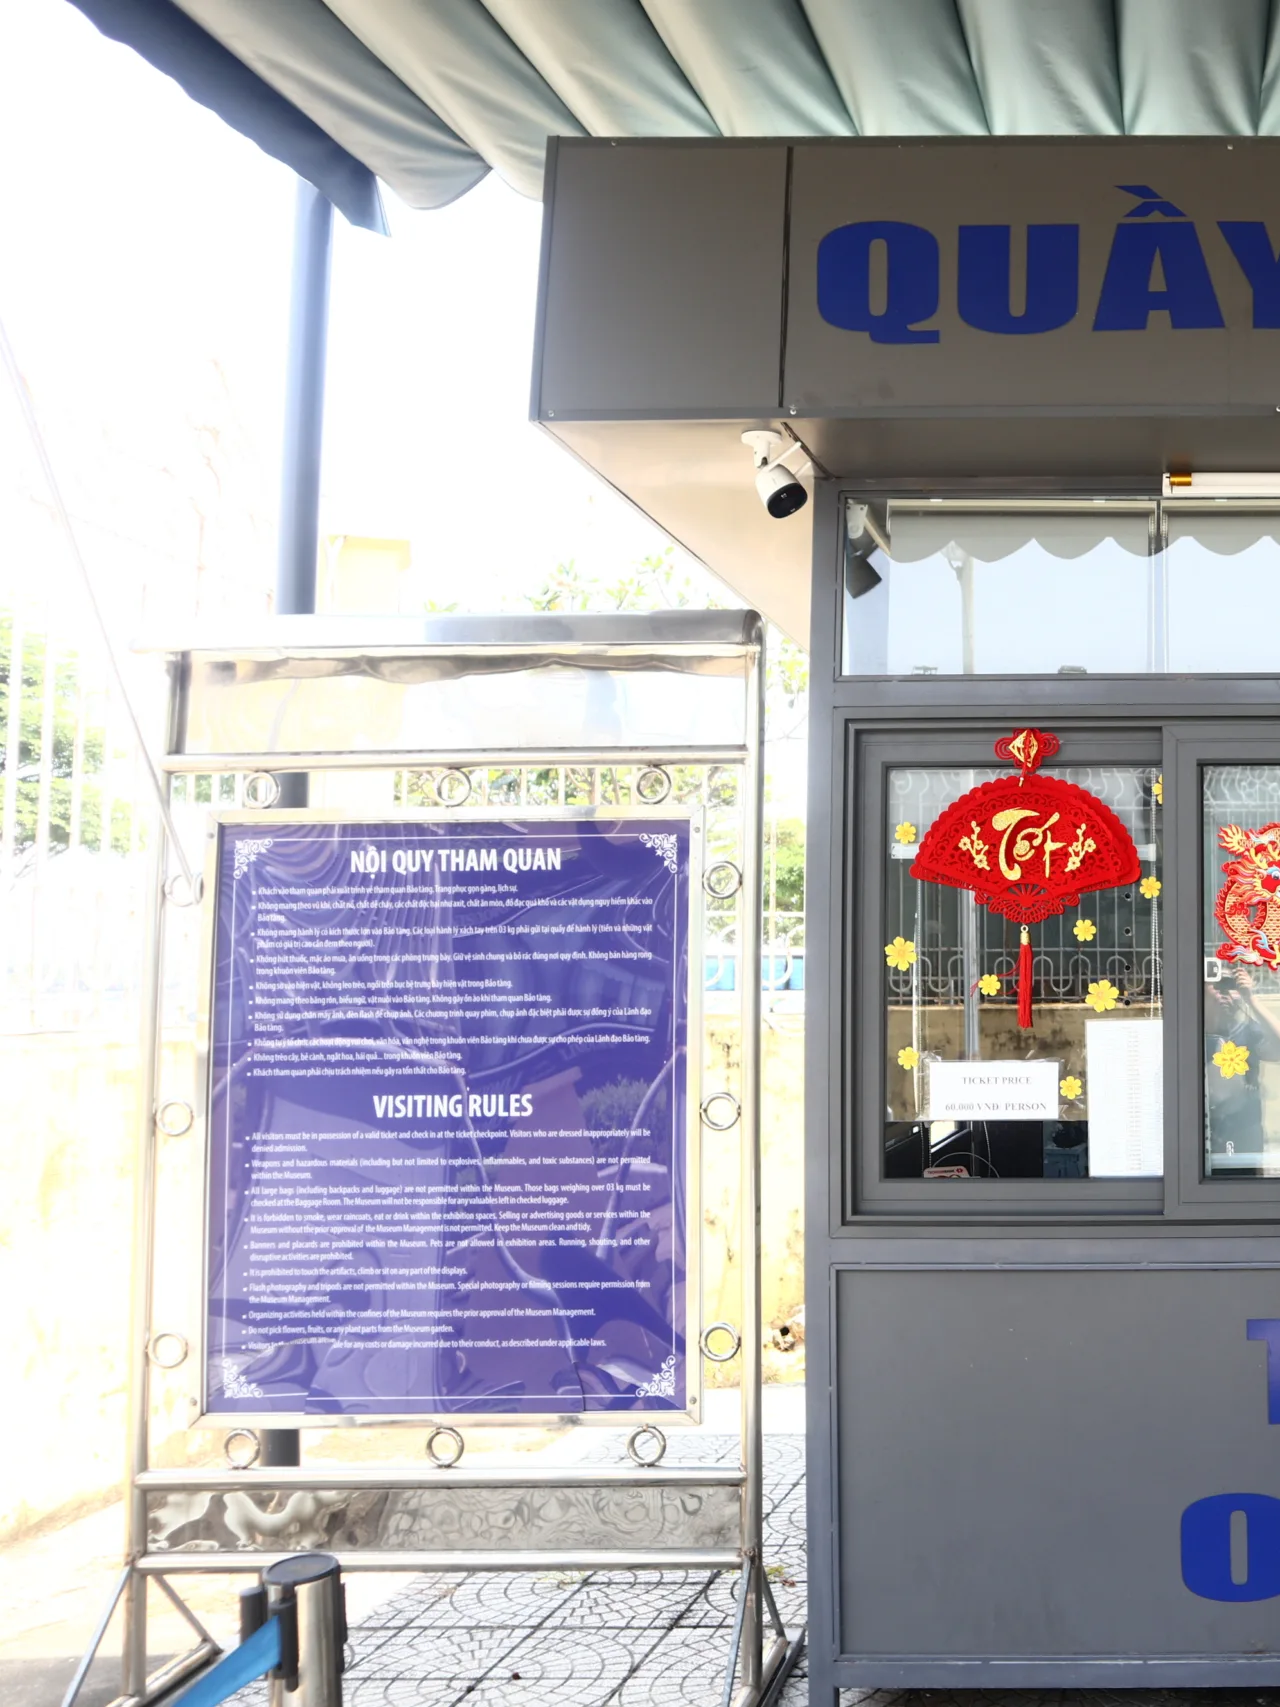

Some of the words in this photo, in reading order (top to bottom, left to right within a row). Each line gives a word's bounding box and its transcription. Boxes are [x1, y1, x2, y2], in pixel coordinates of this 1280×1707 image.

[351, 846, 386, 879] NỘI
[392, 850, 434, 875] QUY
[438, 849, 497, 872] THAM
[503, 848, 561, 874] QUAN
[963, 1077, 999, 1085] TICKET
[1002, 1077, 1032, 1085] PRICE
[373, 1095, 462, 1118] VISITING
[469, 1094, 533, 1117] RULES
[945, 1103, 974, 1111] 60.000
[977, 1102, 999, 1111] VNĐ
[1004, 1102, 1047, 1111] PERSON
[252, 1132, 260, 1140] All
[262, 1132, 284, 1140] visitors
[285, 1132, 301, 1140] must
[303, 1132, 310, 1140] be
[312, 1132, 317, 1140] in
[319, 1132, 351, 1141] possession
[381, 1131, 397, 1139] ticket
[399, 1131, 410, 1139] and
[412, 1131, 428, 1139] check
[430, 1131, 435, 1139] in
[437, 1131, 443, 1139] at
[510, 1130, 532, 1138] Visitors
[533, 1130, 546, 1138] who
[583, 1130, 629, 1139] inappropriately
[643, 1129, 650, 1137] be
[252, 1160, 280, 1169] Weapons
[296, 1159, 328, 1167] hazardous
[360, 1159, 390, 1168] (including
[405, 1158, 415, 1166] not
[417, 1158, 439, 1166] limited
[483, 1158, 527, 1167] inflammables,
[529, 1157, 541, 1165] and
[559, 1157, 594, 1166] substances)
[621, 1156, 650, 1165] permitted
[262, 1187, 278, 1196] large
[296, 1187, 327, 1195] (including
[329, 1186, 360, 1195] backpacks
[375, 1186, 403, 1195] luggage)
[428, 1185, 458, 1194] permitted
[544, 1184, 559, 1193] bags
[561, 1184, 590, 1193] weighing
[616, 1184, 624, 1193] kg
[278, 1241, 290, 1249] and
[292, 1241, 318, 1250] placards
[332, 1241, 364, 1250] prohibited
